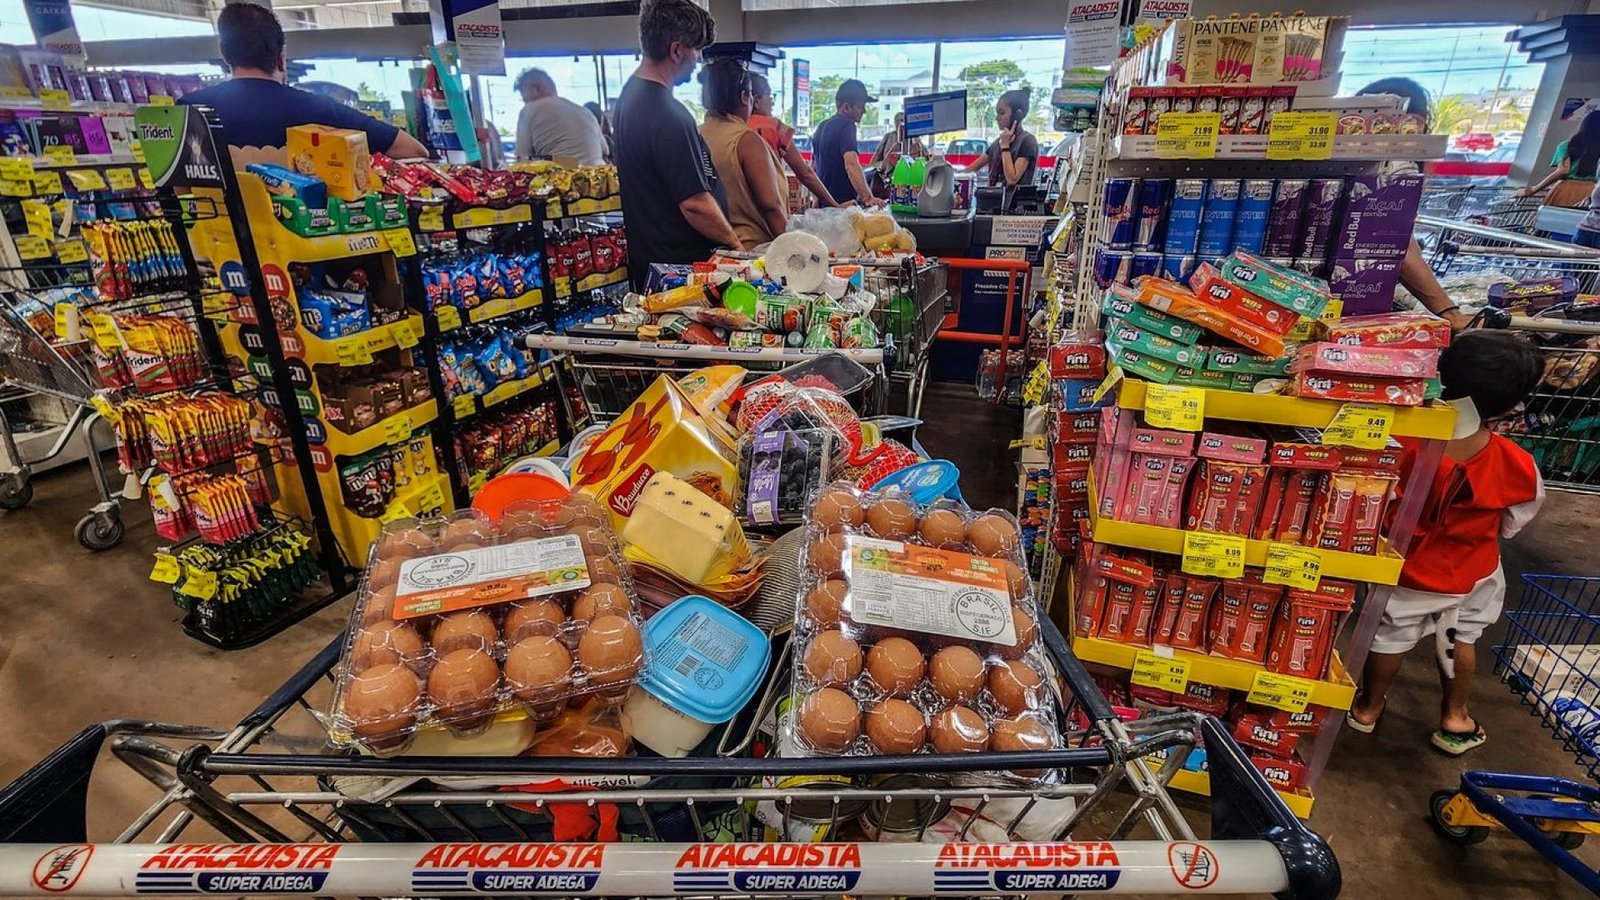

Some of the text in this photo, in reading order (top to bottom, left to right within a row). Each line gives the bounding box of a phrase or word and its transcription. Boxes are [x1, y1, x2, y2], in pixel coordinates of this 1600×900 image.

[1071, 1, 1119, 15] ATACADISTA
[1143, 1, 1189, 11] ATACADISTA
[1194, 20, 1256, 35] PANTENE
[1261, 17, 1324, 32] PANTENE
[140, 125, 173, 139] Trident
[1309, 127, 1329, 135] 31.90
[226, 270, 246, 288] m
[266, 272, 283, 287] m
[245, 333, 263, 349] m
[282, 336, 300, 351] m
[125, 355, 162, 366] Trident
[253, 362, 272, 377] m
[1081, 386, 1097, 397] Fin
[1182, 400, 1198, 408] 9.49
[1367, 418, 1386, 426] 9.49
[613, 468, 650, 514] Bauducco
[1225, 548, 1241, 556] 8.99
[1303, 561, 1320, 571] 8.99
[961, 595, 998, 613] BRASIL
[141, 844, 343, 869] ATACADISTA
[415, 844, 607, 868] ATACADISTA
[675, 844, 861, 868] ATACADISTA
[935, 842, 1120, 867] ATACADISTA
[209, 876, 313, 890] SUPER ADEGA
[484, 875, 586, 889] SUPER ADEGA
[745, 875, 846, 889] SUPER ADEGA
[1005, 874, 1107, 888] SUPER ADEGA
